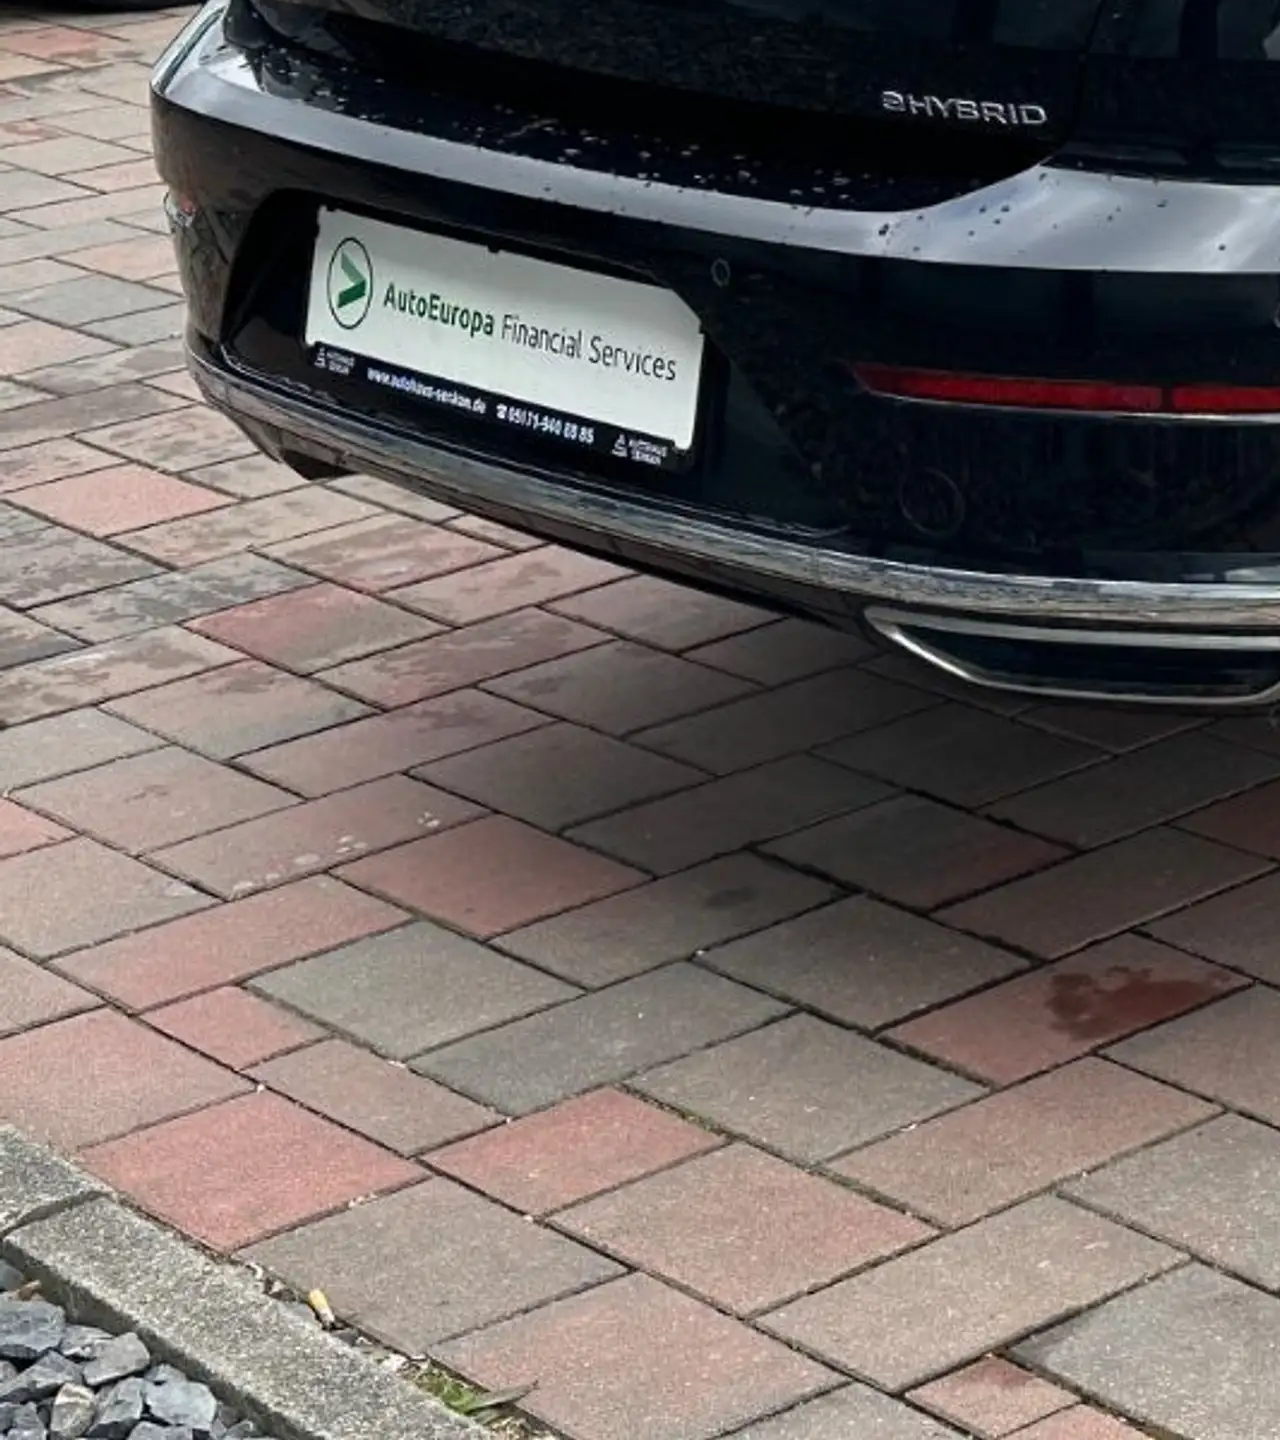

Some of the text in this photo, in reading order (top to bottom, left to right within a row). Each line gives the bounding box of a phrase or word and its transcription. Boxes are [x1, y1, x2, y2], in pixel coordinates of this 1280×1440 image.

[383, 282, 678, 382] AutoEuropa Financial Services
